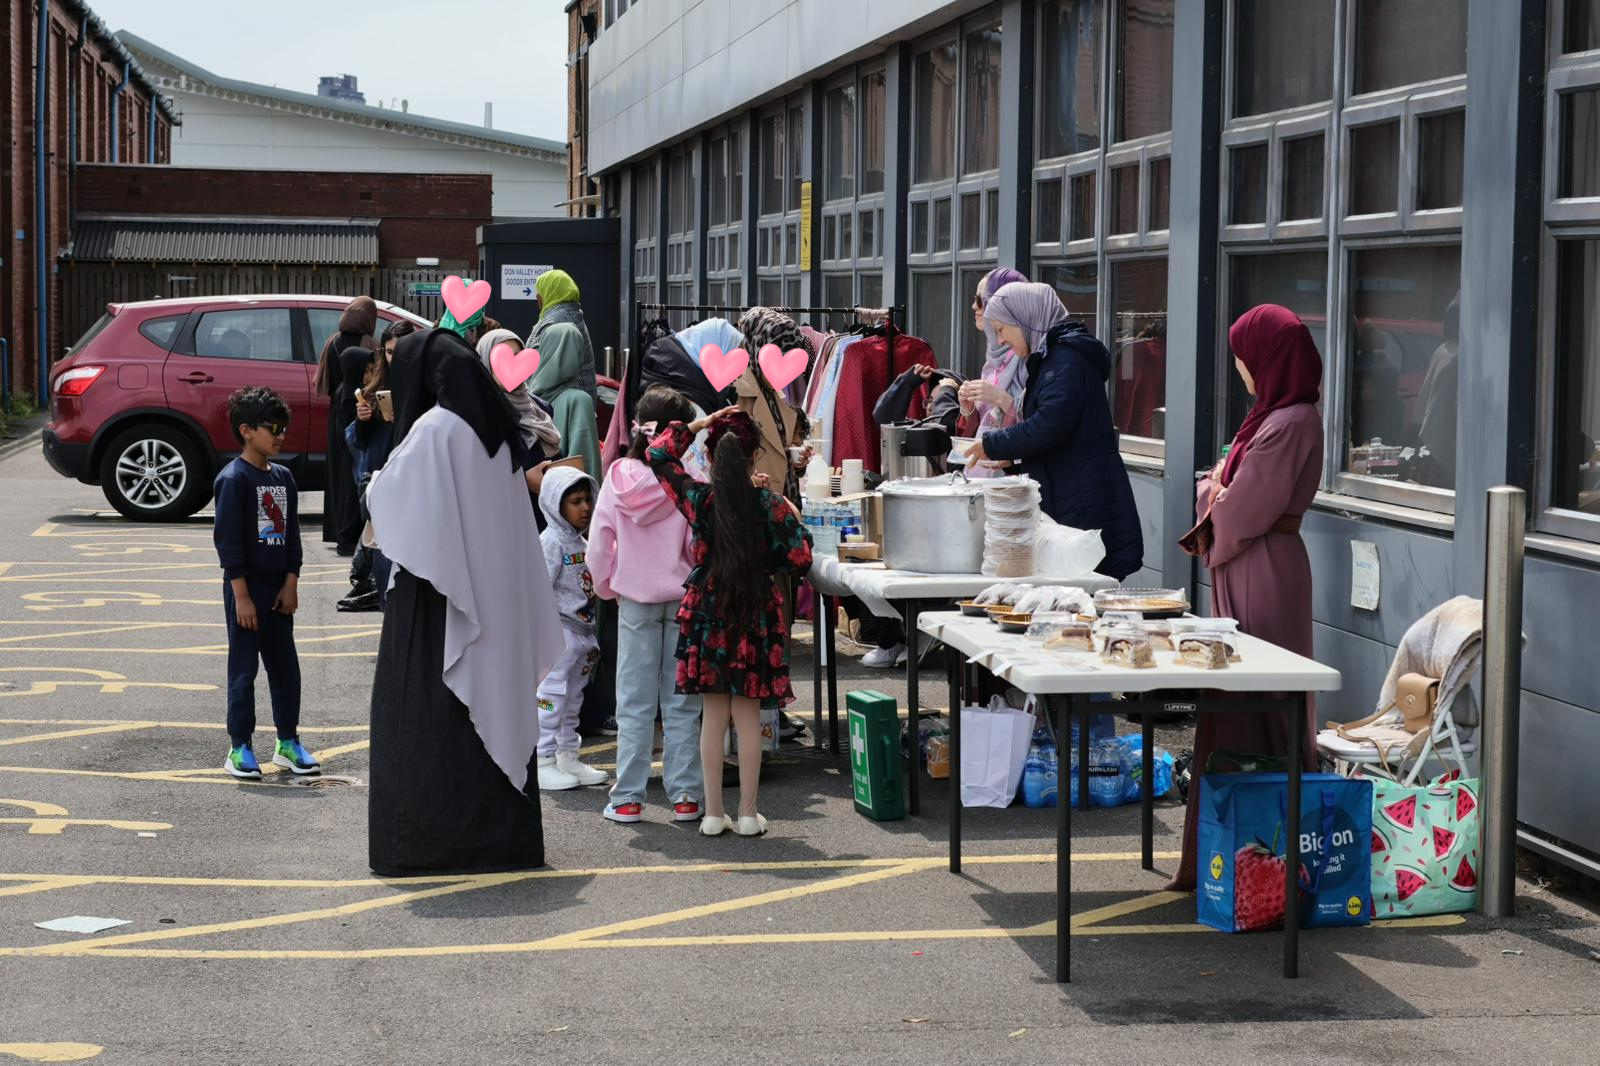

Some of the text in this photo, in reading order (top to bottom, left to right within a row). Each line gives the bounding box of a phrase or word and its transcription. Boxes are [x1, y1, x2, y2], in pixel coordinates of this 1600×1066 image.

[505, 268, 515, 276] DON
[516, 268, 534, 276] VALLEY
[506, 278, 536, 286] GOODS ENTR
[256, 486, 287, 495] SPIDER
[1299, 829, 1354, 855] Big on
